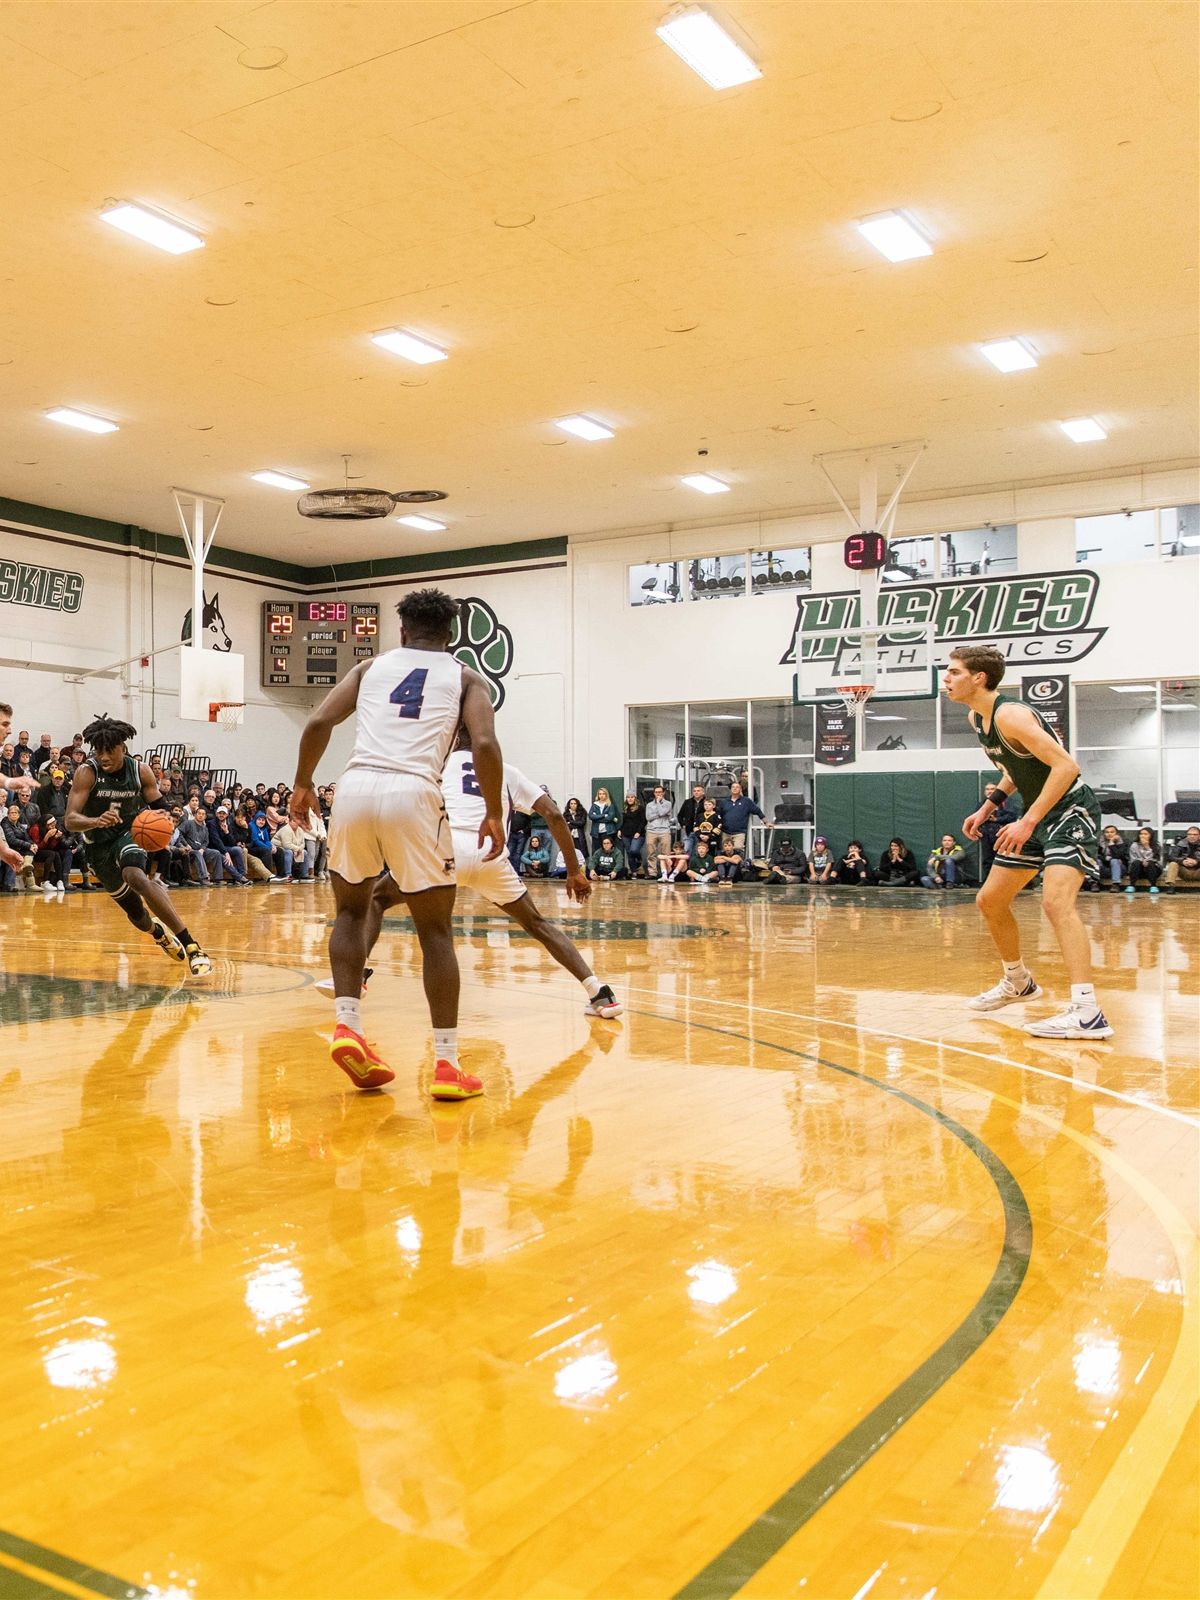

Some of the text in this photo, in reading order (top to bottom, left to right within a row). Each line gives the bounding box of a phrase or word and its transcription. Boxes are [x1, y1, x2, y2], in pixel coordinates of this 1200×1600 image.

[848, 538, 883, 564] 21
[271, 603, 290, 612] Home
[309, 603, 347, 620] 6:38
[353, 605, 377, 614] Guests
[780, 570, 1100, 664] HUSKIES
[271, 615, 293, 633] 29
[355, 617, 377, 634] 25
[311, 632, 333, 641] period
[272, 646, 289, 654] fouls
[311, 647, 334, 655] player
[355, 648, 372, 656] fouls
[848, 638, 1073, 668] ATHICS
[277, 659, 286, 671] 4
[313, 676, 331, 684] game
[389, 668, 429, 719] 4
